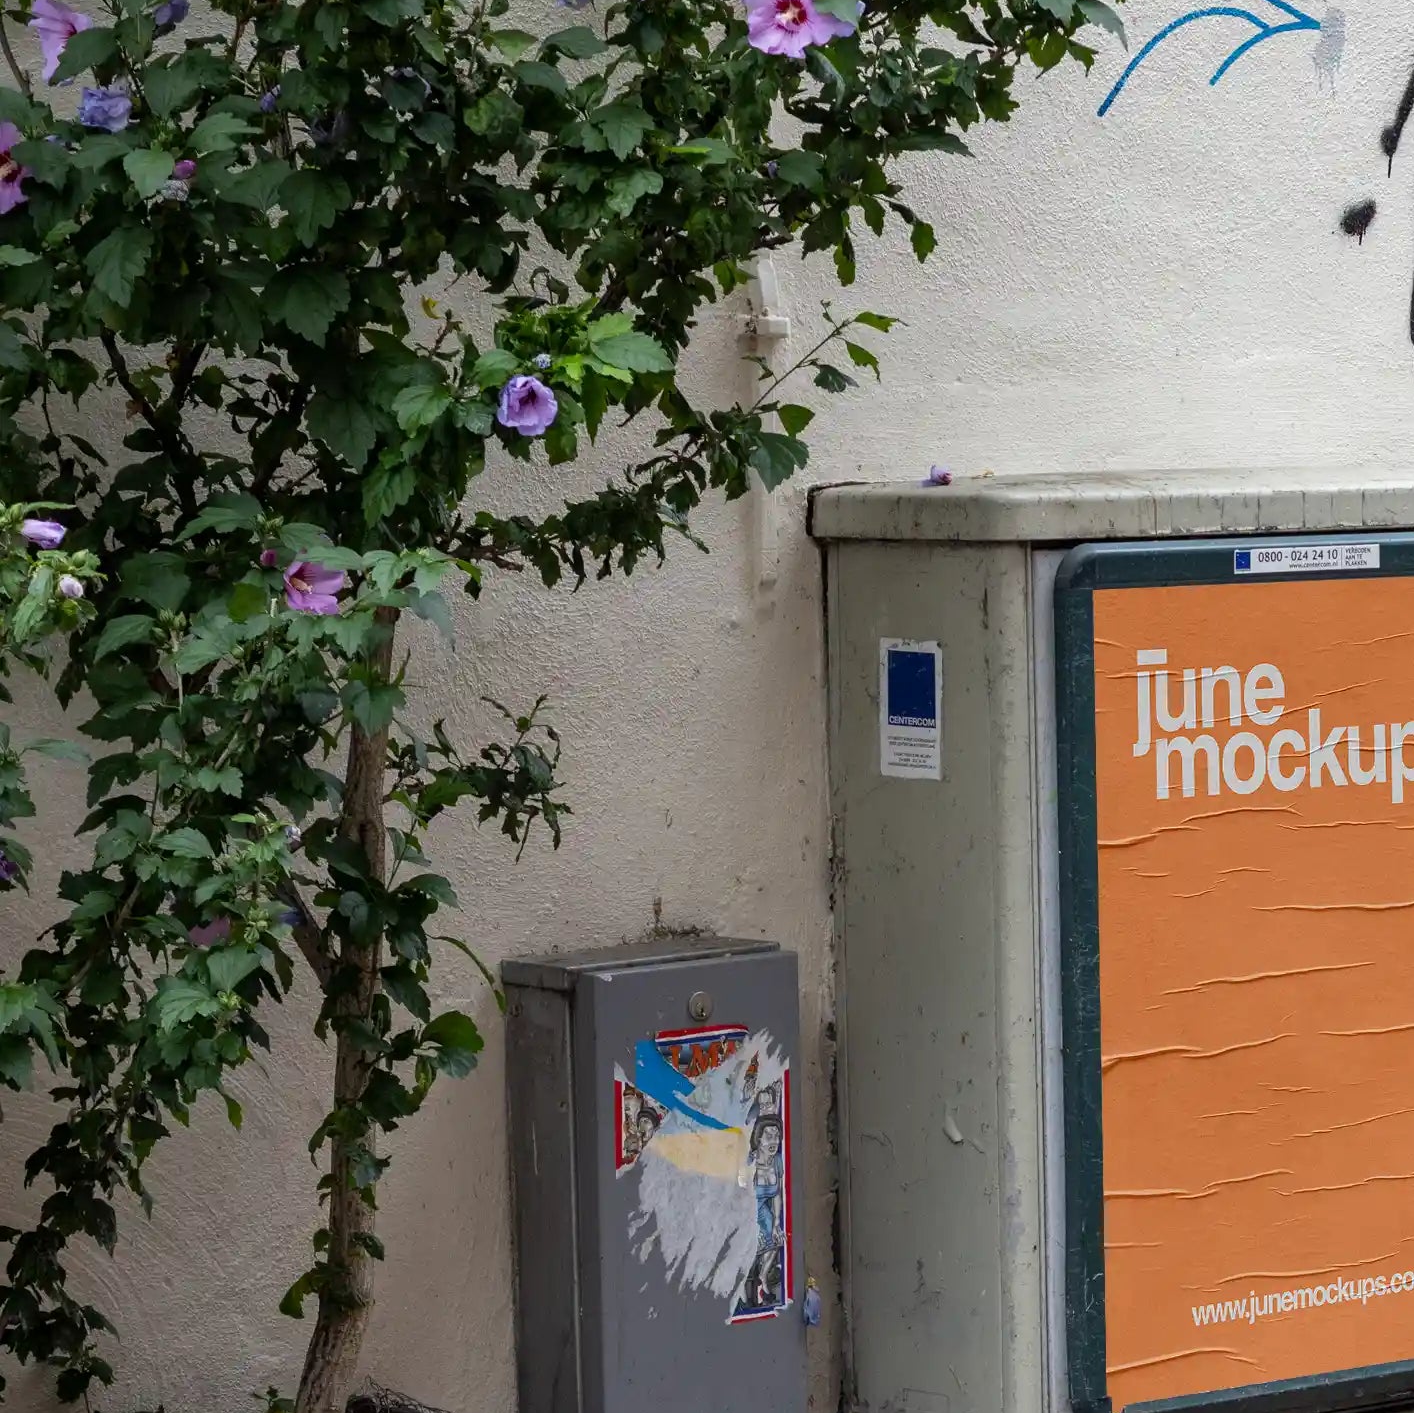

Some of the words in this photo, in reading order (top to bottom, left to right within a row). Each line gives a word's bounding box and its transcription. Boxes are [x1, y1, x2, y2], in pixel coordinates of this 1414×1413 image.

[1258, 551, 1283, 563] 0800
[1290, 550, 1308, 562] 024
[1312, 549, 1324, 561] 24
[1328, 549, 1338, 560] 10
[1133, 648, 1286, 757] june
[889, 716, 936, 727] CENTERCOM
